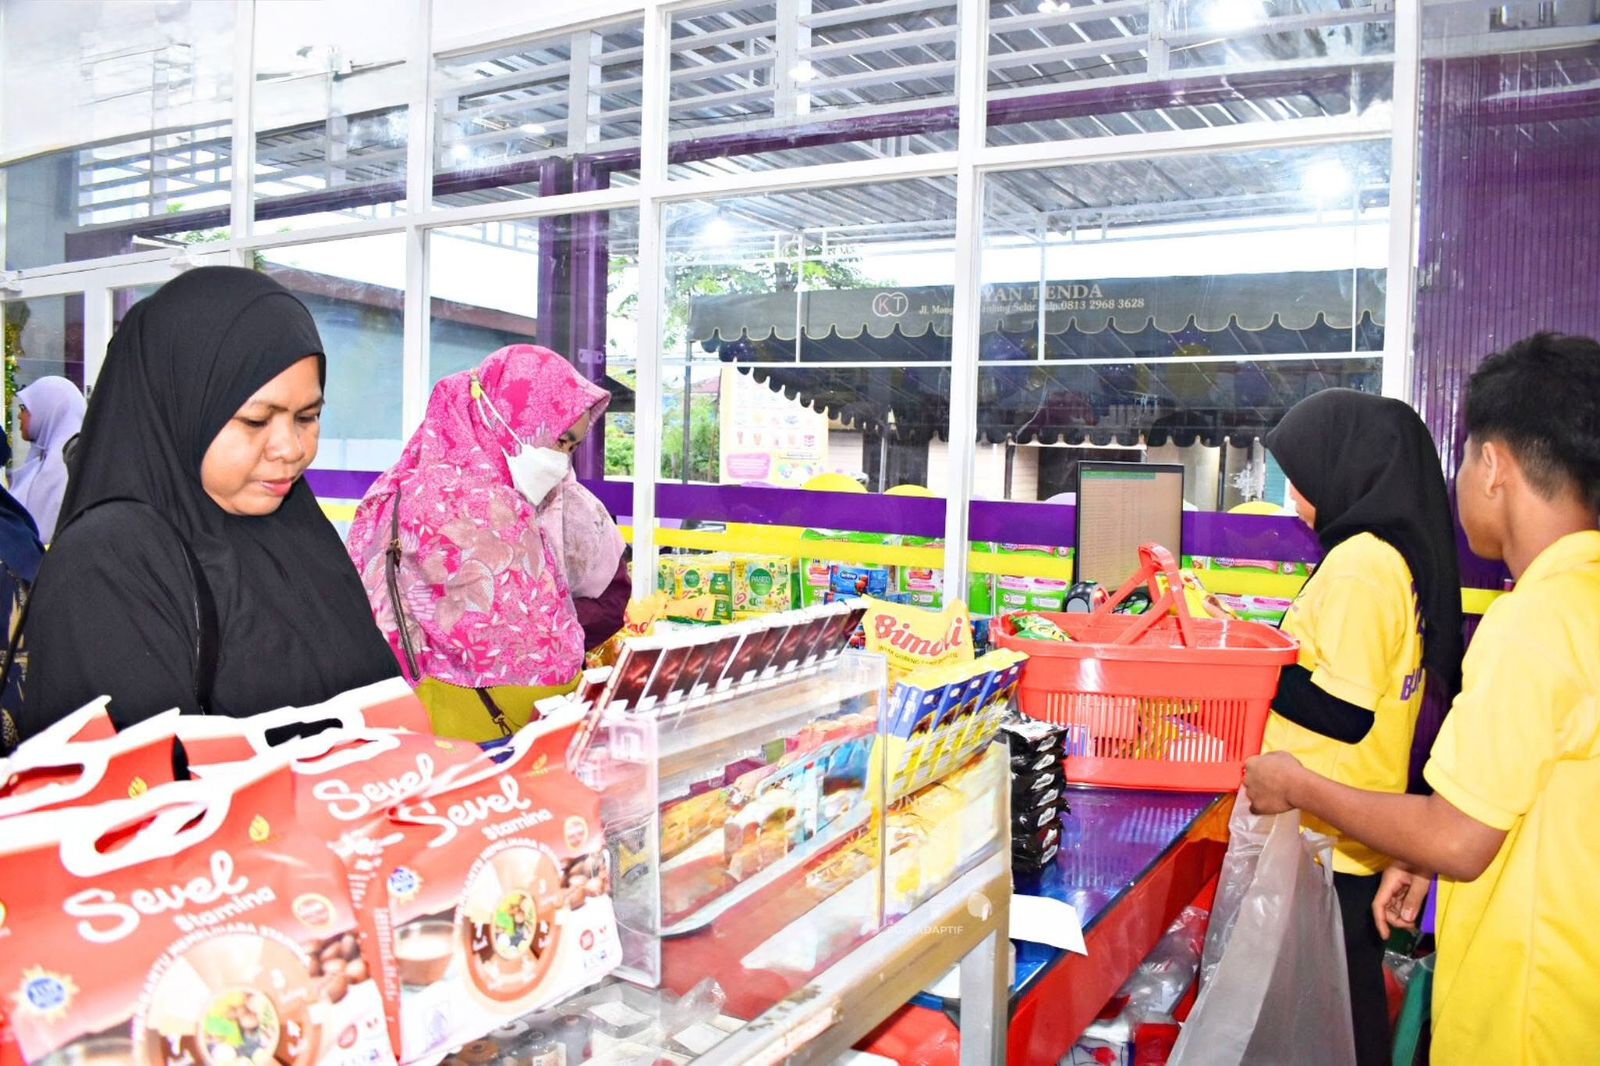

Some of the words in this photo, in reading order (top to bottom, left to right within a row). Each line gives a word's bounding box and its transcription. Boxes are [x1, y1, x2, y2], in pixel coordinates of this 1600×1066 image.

[1028, 283, 1103, 301] TENDA
[1089, 298, 1115, 310] 2968
[1117, 296, 1145, 309] 3628
[312, 753, 435, 821] Sevel
[397, 774, 532, 849] Sevel
[481, 808, 554, 840] Stamina
[64, 851, 248, 943] Sevel
[173, 886, 277, 932] Stamina
